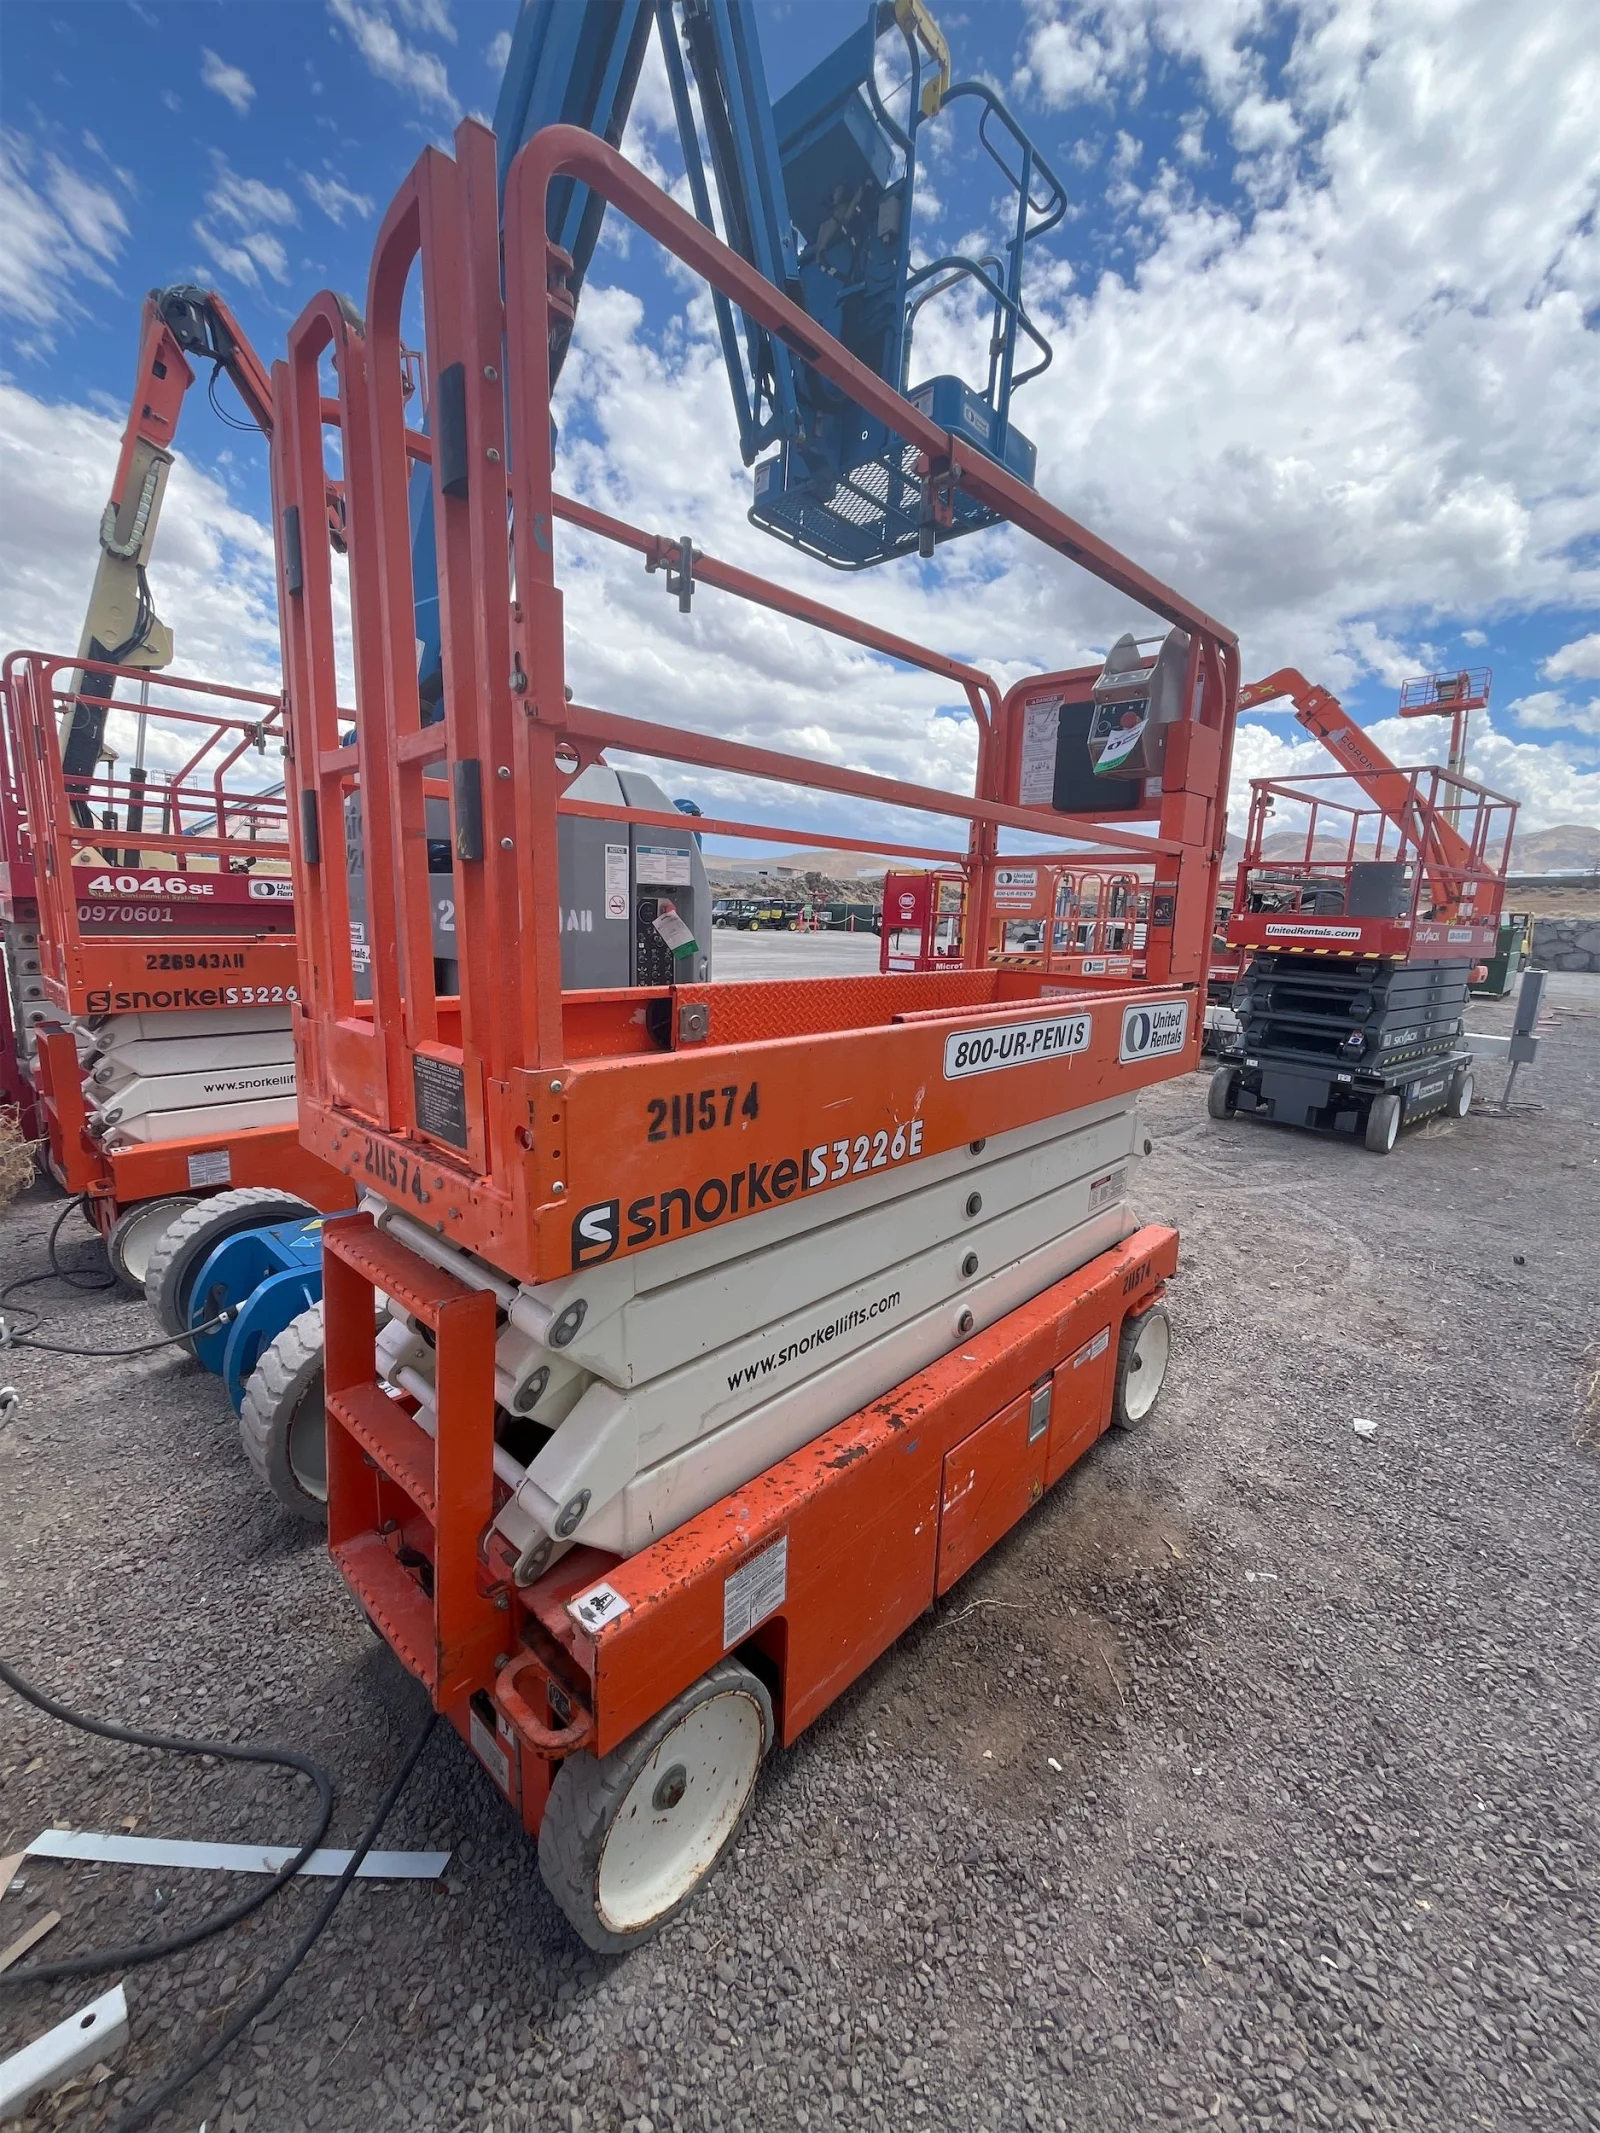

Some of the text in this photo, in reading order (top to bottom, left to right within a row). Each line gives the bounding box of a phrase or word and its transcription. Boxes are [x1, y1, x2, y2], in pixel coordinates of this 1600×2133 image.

[1341, 735, 1379, 778] CORON
[88, 875, 214, 896] 4046SE
[1267, 925, 1360, 939] UnitedRentals.com
[1416, 928, 1440, 943] SKYJACK
[116, 987, 225, 1009] snorkel
[1153, 1010, 1182, 1029] United
[955, 1022, 1085, 1068] 800-UR-PENIS
[1150, 1028, 1182, 1048] Rentals
[203, 1075, 297, 1093] www.snorkellif
[647, 1082, 759, 1142] 211574
[365, 1136, 422, 1204] 211574
[627, 1149, 810, 1247] snorkel
[809, 1119, 924, 1188] S3226E
[1122, 1260, 1150, 1296] 211574
[727, 1291, 900, 1391] www.snorkellifts.com
